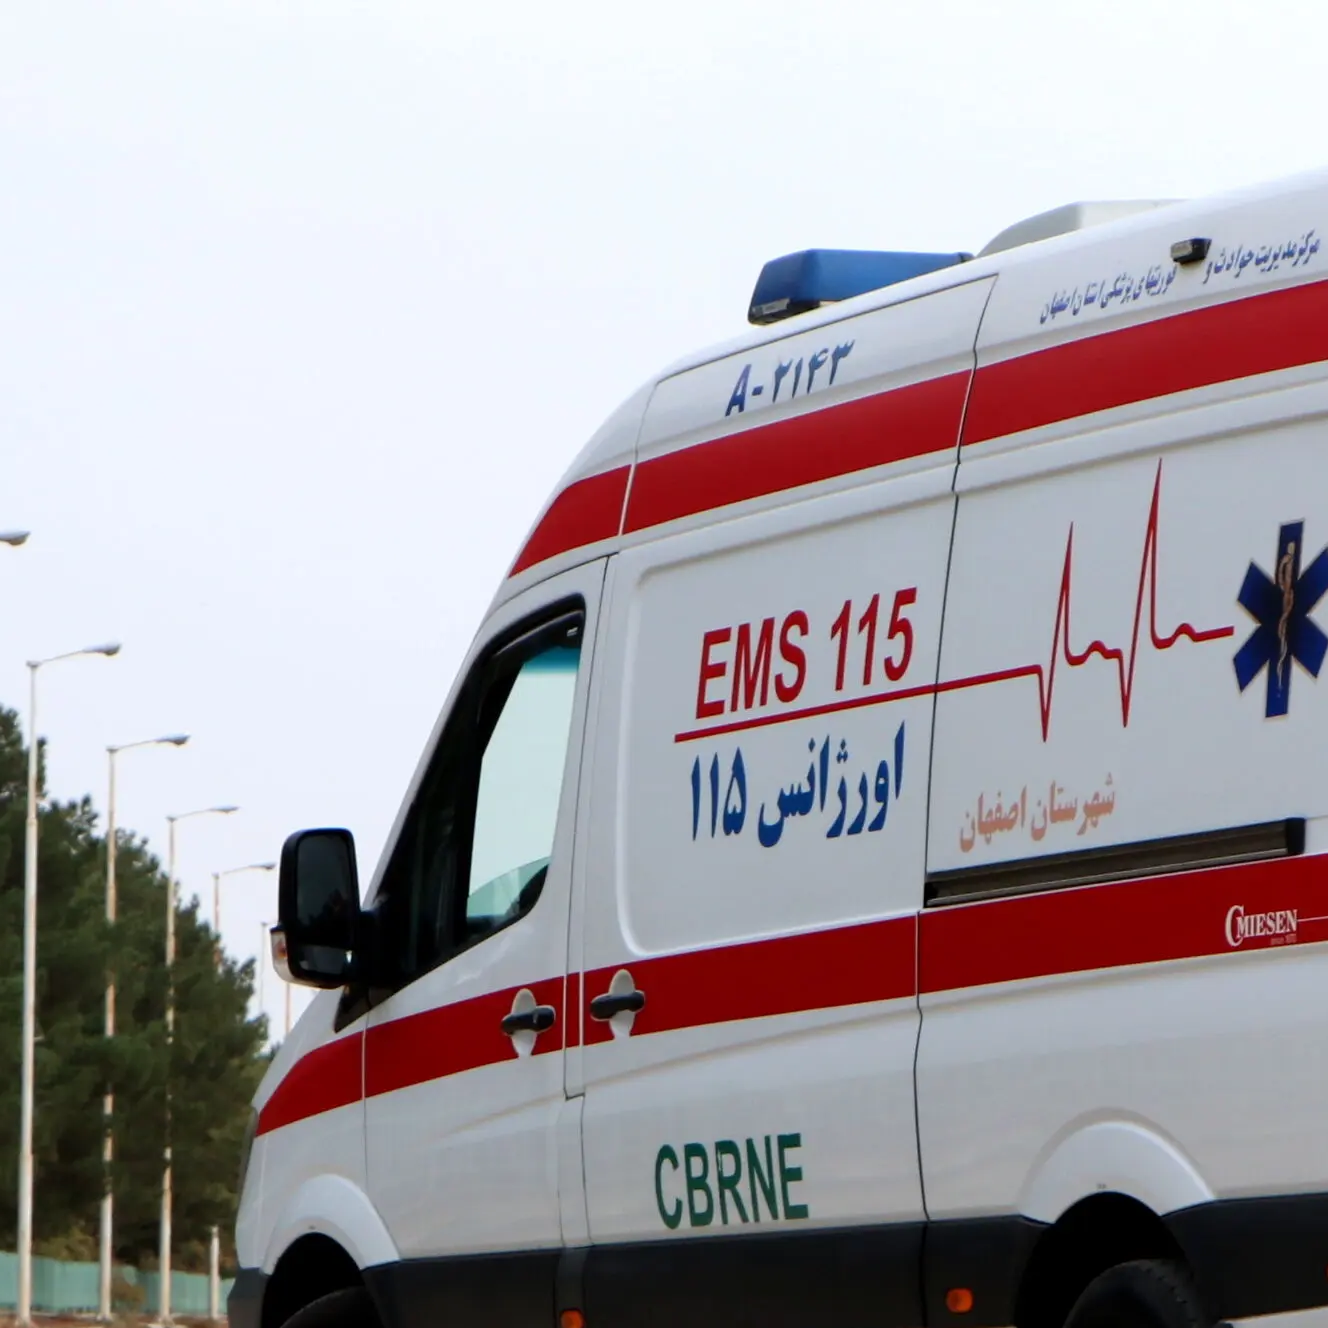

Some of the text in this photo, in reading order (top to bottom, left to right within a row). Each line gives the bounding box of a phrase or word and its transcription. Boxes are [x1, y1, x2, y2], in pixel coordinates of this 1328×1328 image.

[1255, 240, 1297, 272] مدیریت
[1292, 229, 1320, 267] مرکز
[695, 587, 918, 720] EMS 115
[691, 719, 905, 848] اورژانس ۱۱۵
[959, 771, 1116, 853] شهرستان اصفهان
[655, 1132, 809, 1230] CBRNE
